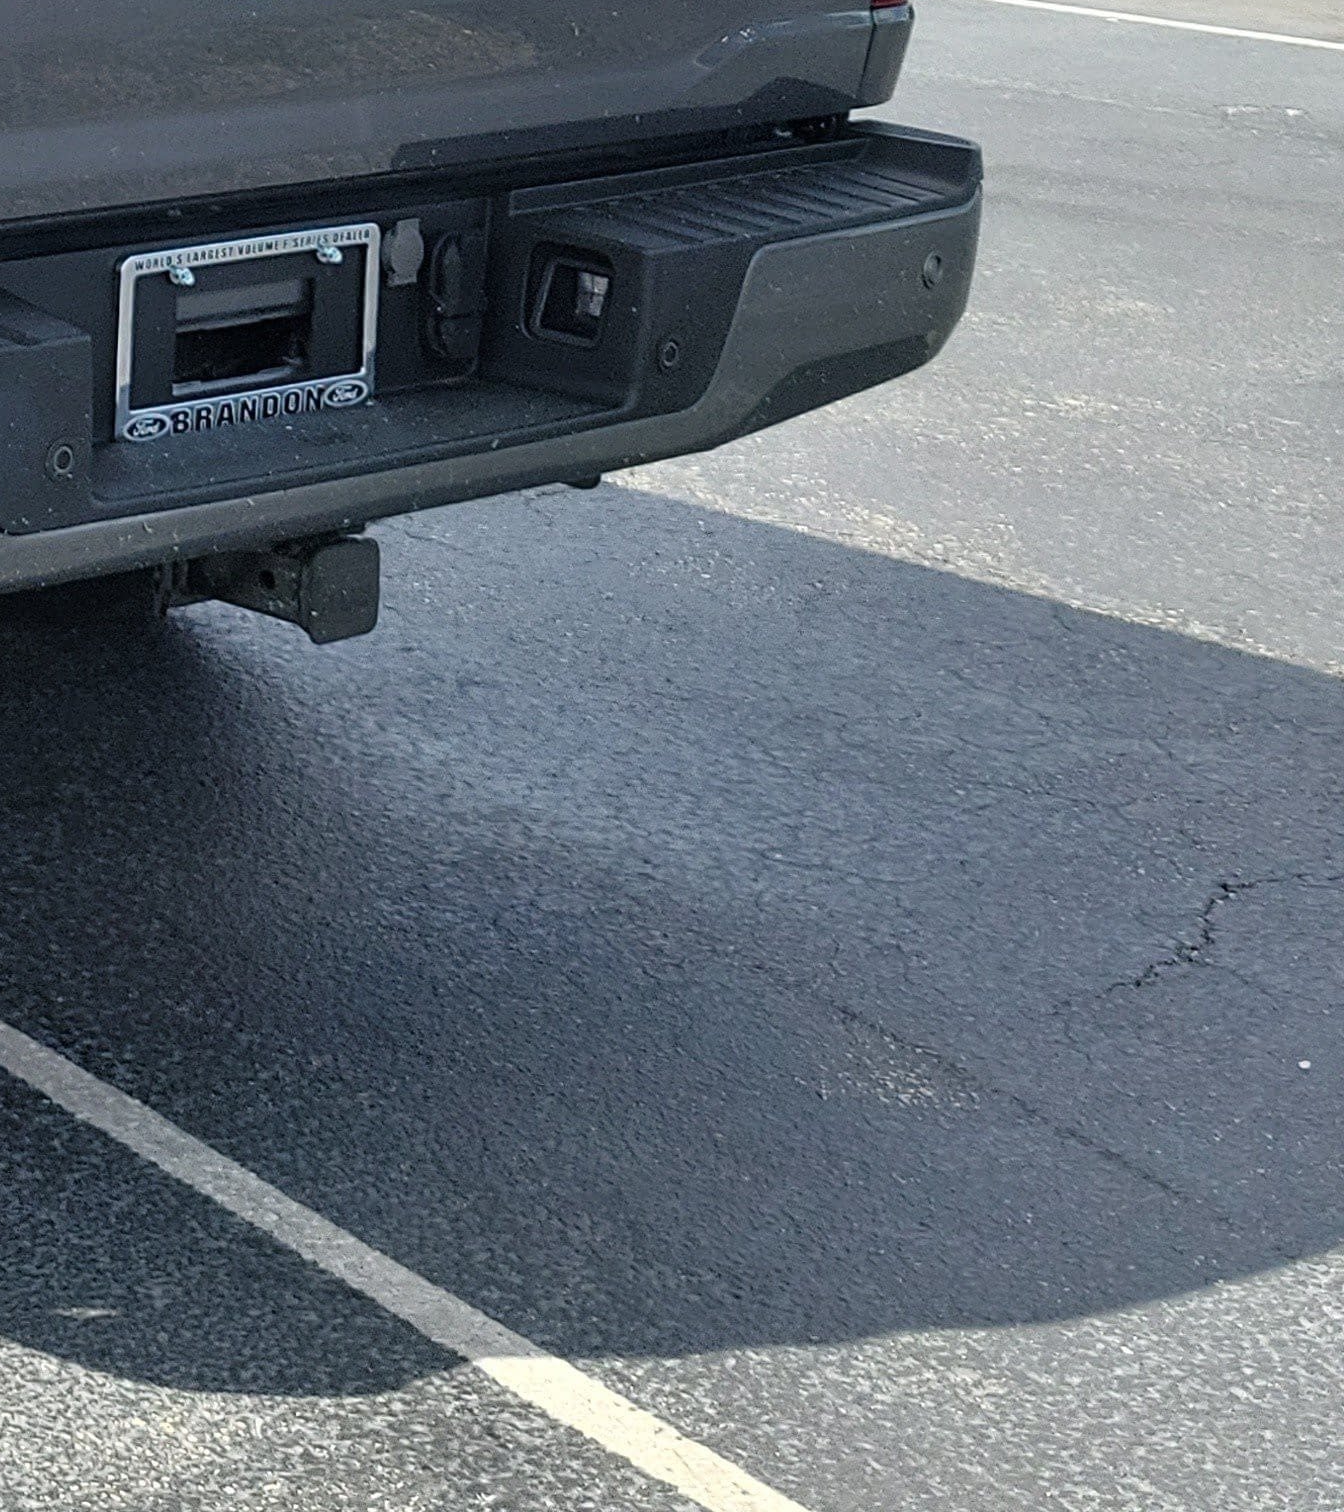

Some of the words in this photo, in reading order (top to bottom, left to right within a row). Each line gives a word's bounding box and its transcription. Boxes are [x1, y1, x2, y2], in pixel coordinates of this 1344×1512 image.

[134, 253, 183, 271] WORLDS
[186, 246, 235, 264] LARGEST
[237, 240, 279, 255] VOLUME
[170, 386, 325, 435] BRANDON
